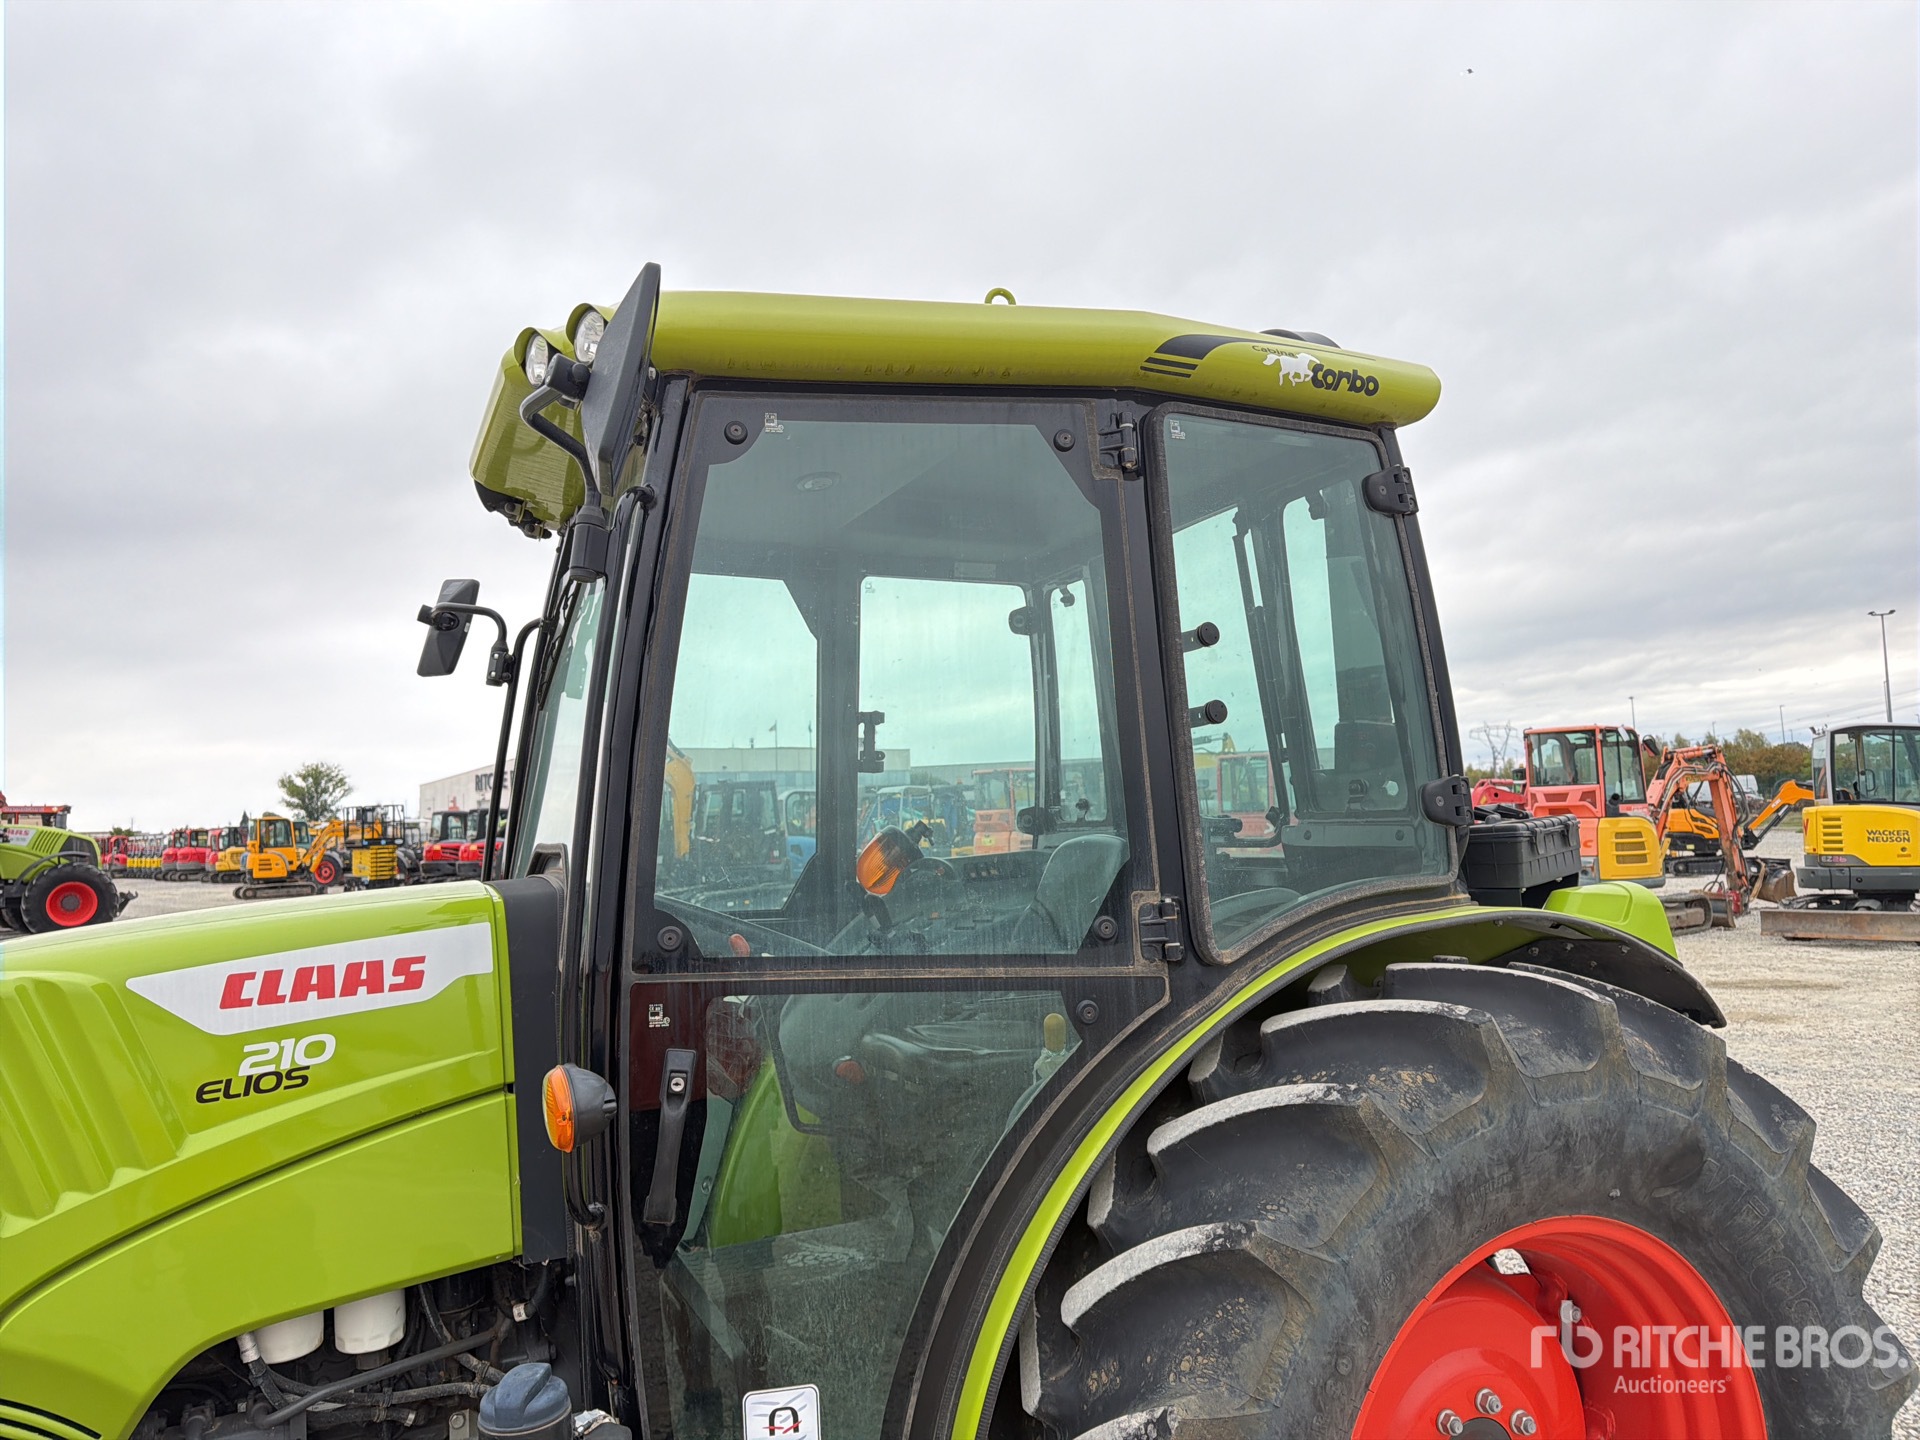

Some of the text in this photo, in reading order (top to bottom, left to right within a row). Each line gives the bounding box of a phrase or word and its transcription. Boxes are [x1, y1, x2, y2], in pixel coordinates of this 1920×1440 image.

[220, 956, 426, 1010] CLAAS
[238, 1034, 336, 1076] 210
[196, 1066, 310, 1103] ELIOS
